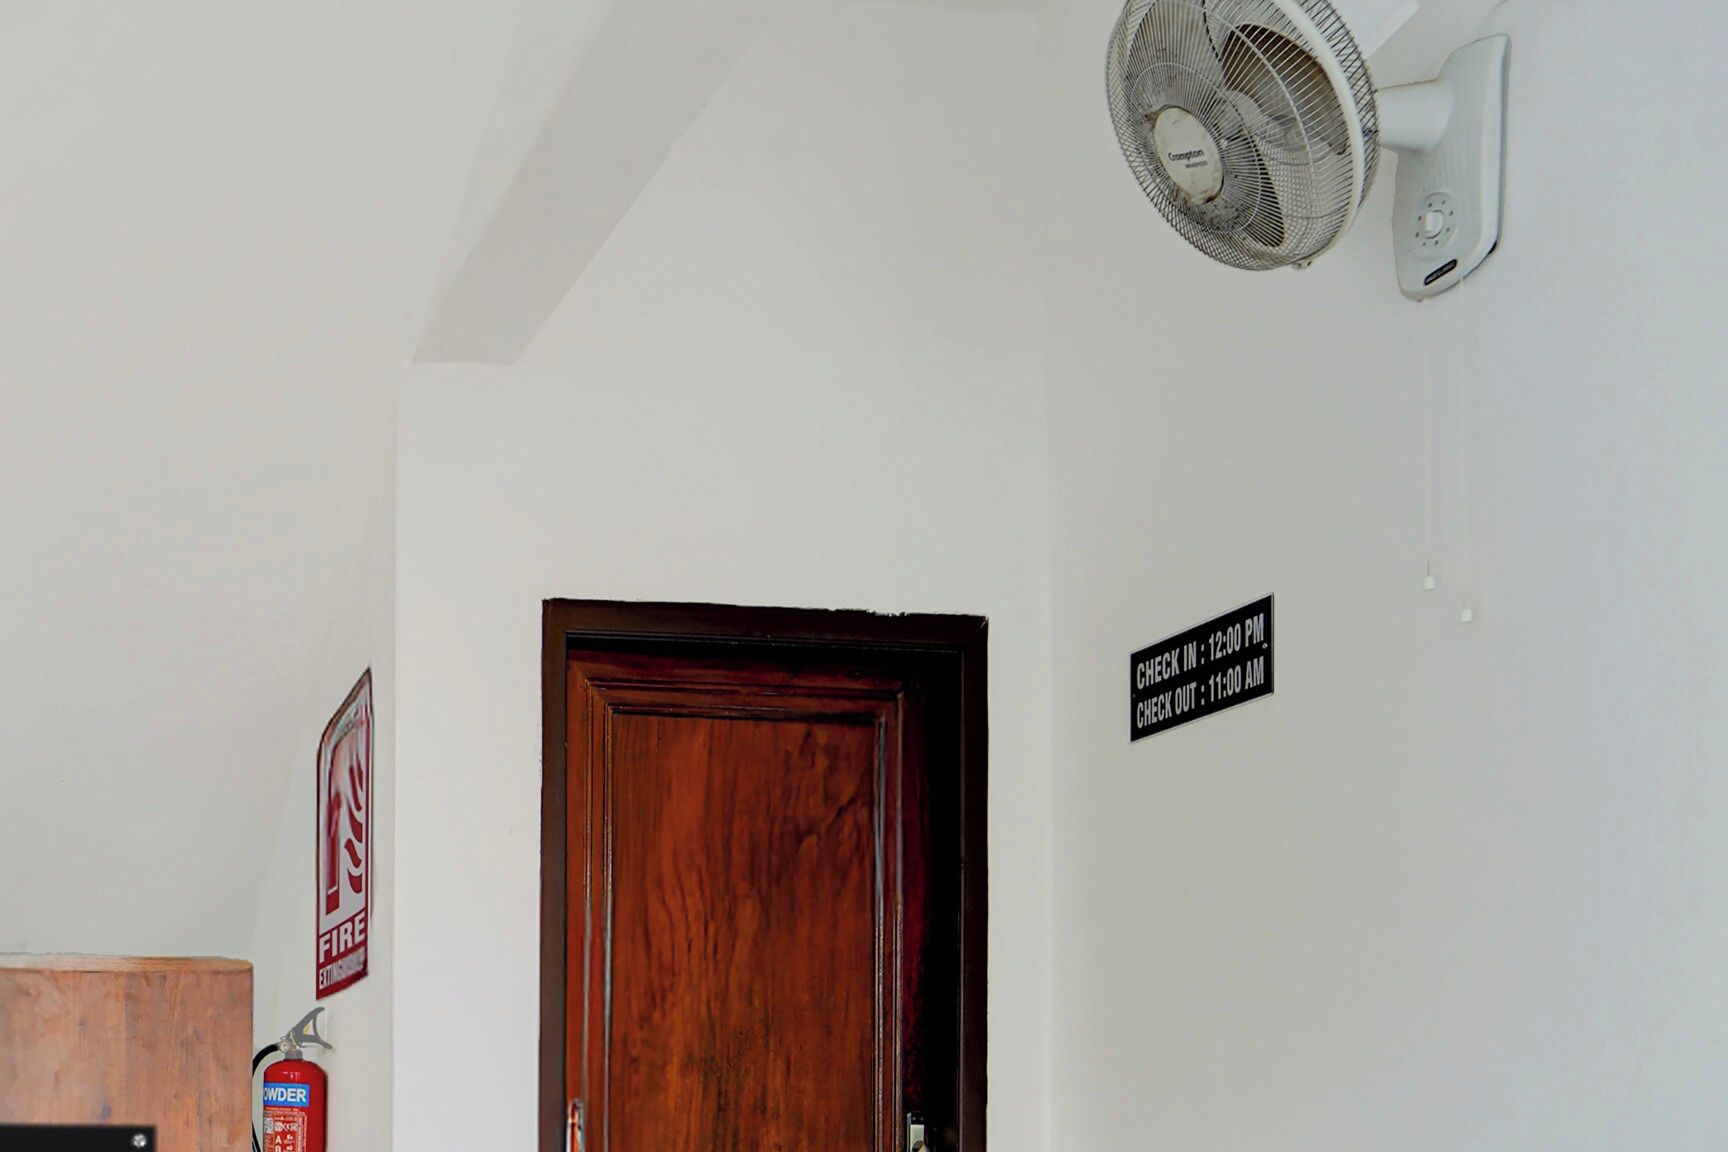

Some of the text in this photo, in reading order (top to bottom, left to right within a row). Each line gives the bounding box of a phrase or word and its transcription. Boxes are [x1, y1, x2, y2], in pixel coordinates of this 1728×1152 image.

[1136, 648, 1179, 690] CHECK
[1183, 641, 1196, 672] IN
[1209, 623, 1241, 661] 12:00
[1245, 613, 1264, 647] PM
[1136, 691, 1172, 729] CHECK
[1175, 681, 1196, 715] OUT
[1209, 665, 1241, 702] 11:00
[1245, 656, 1264, 690] AM
[319, 911, 365, 964] FIRE
[275, 1135, 282, 1144] A
